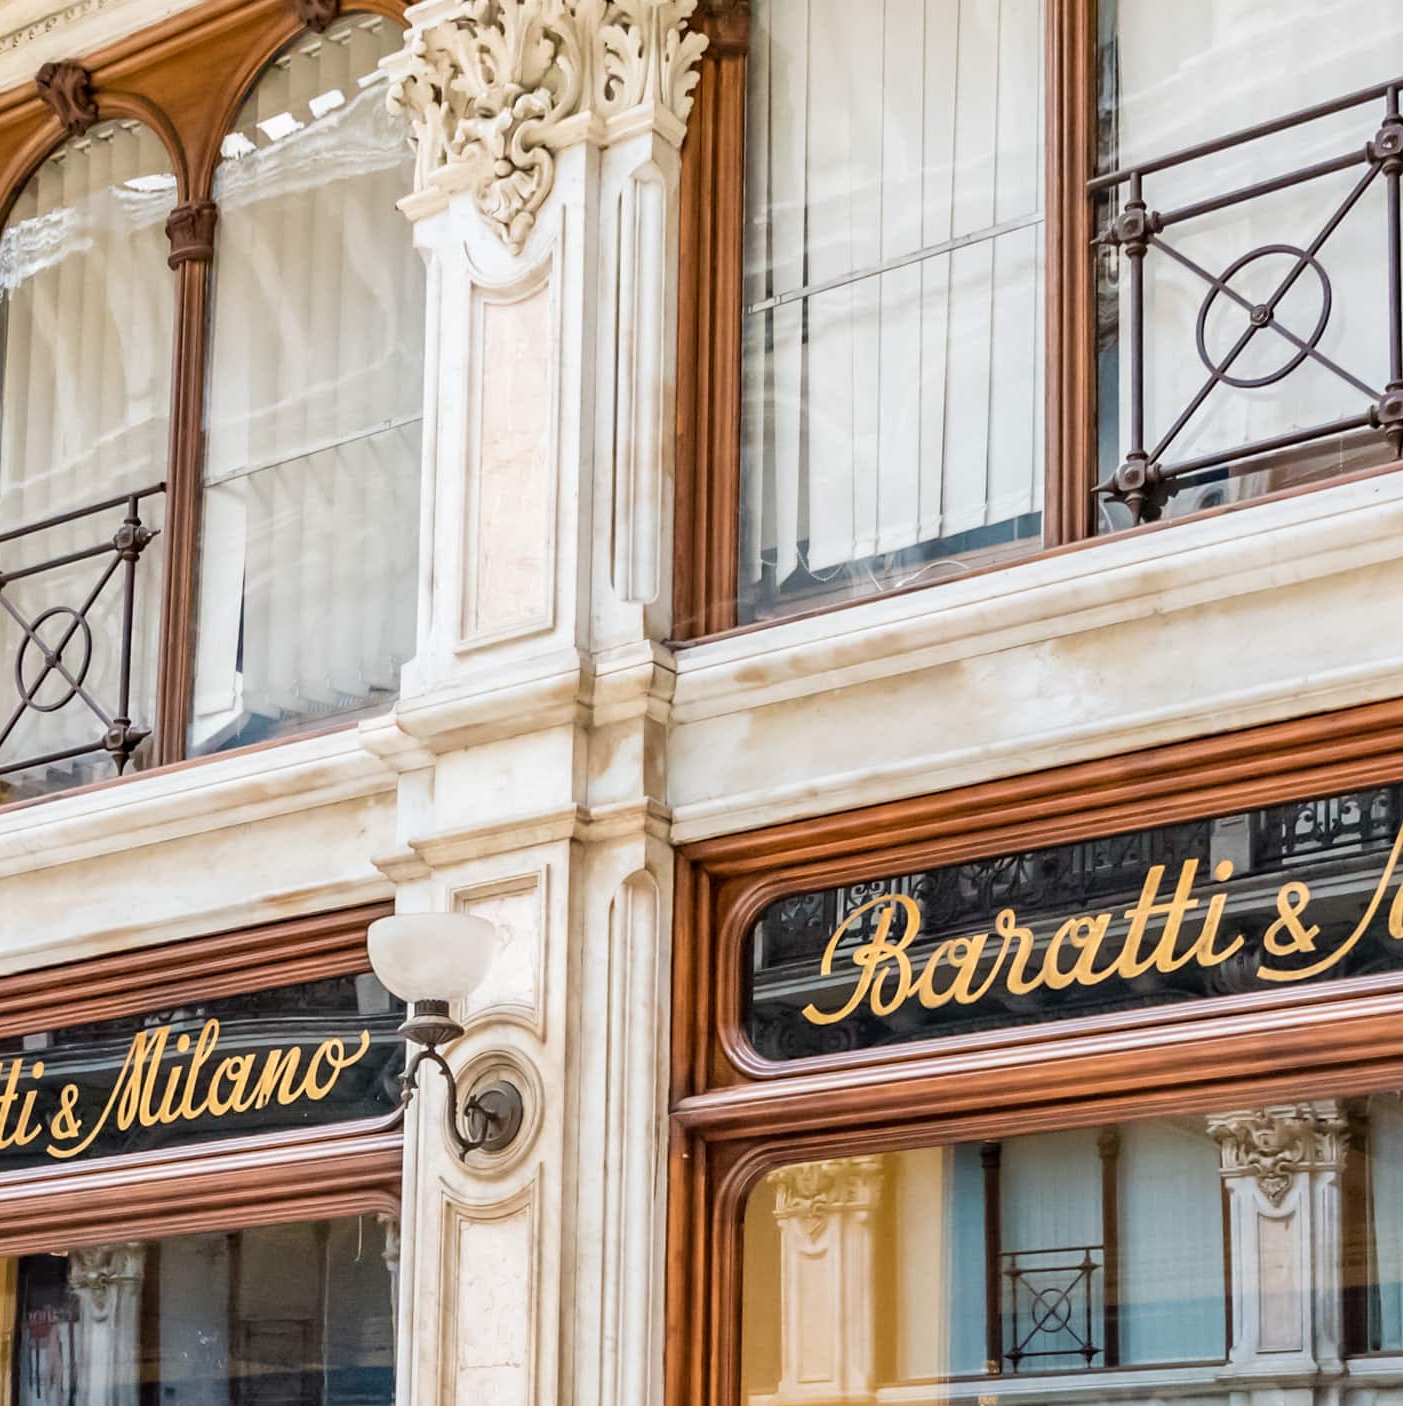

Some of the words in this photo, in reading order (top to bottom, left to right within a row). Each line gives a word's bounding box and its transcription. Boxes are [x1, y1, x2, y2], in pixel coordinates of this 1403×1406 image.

[803, 858, 1245, 1024] Baratti
[1263, 881, 1320, 956] &
[46, 1018, 370, 1158] Milano
[50, 1083, 82, 1140] &
